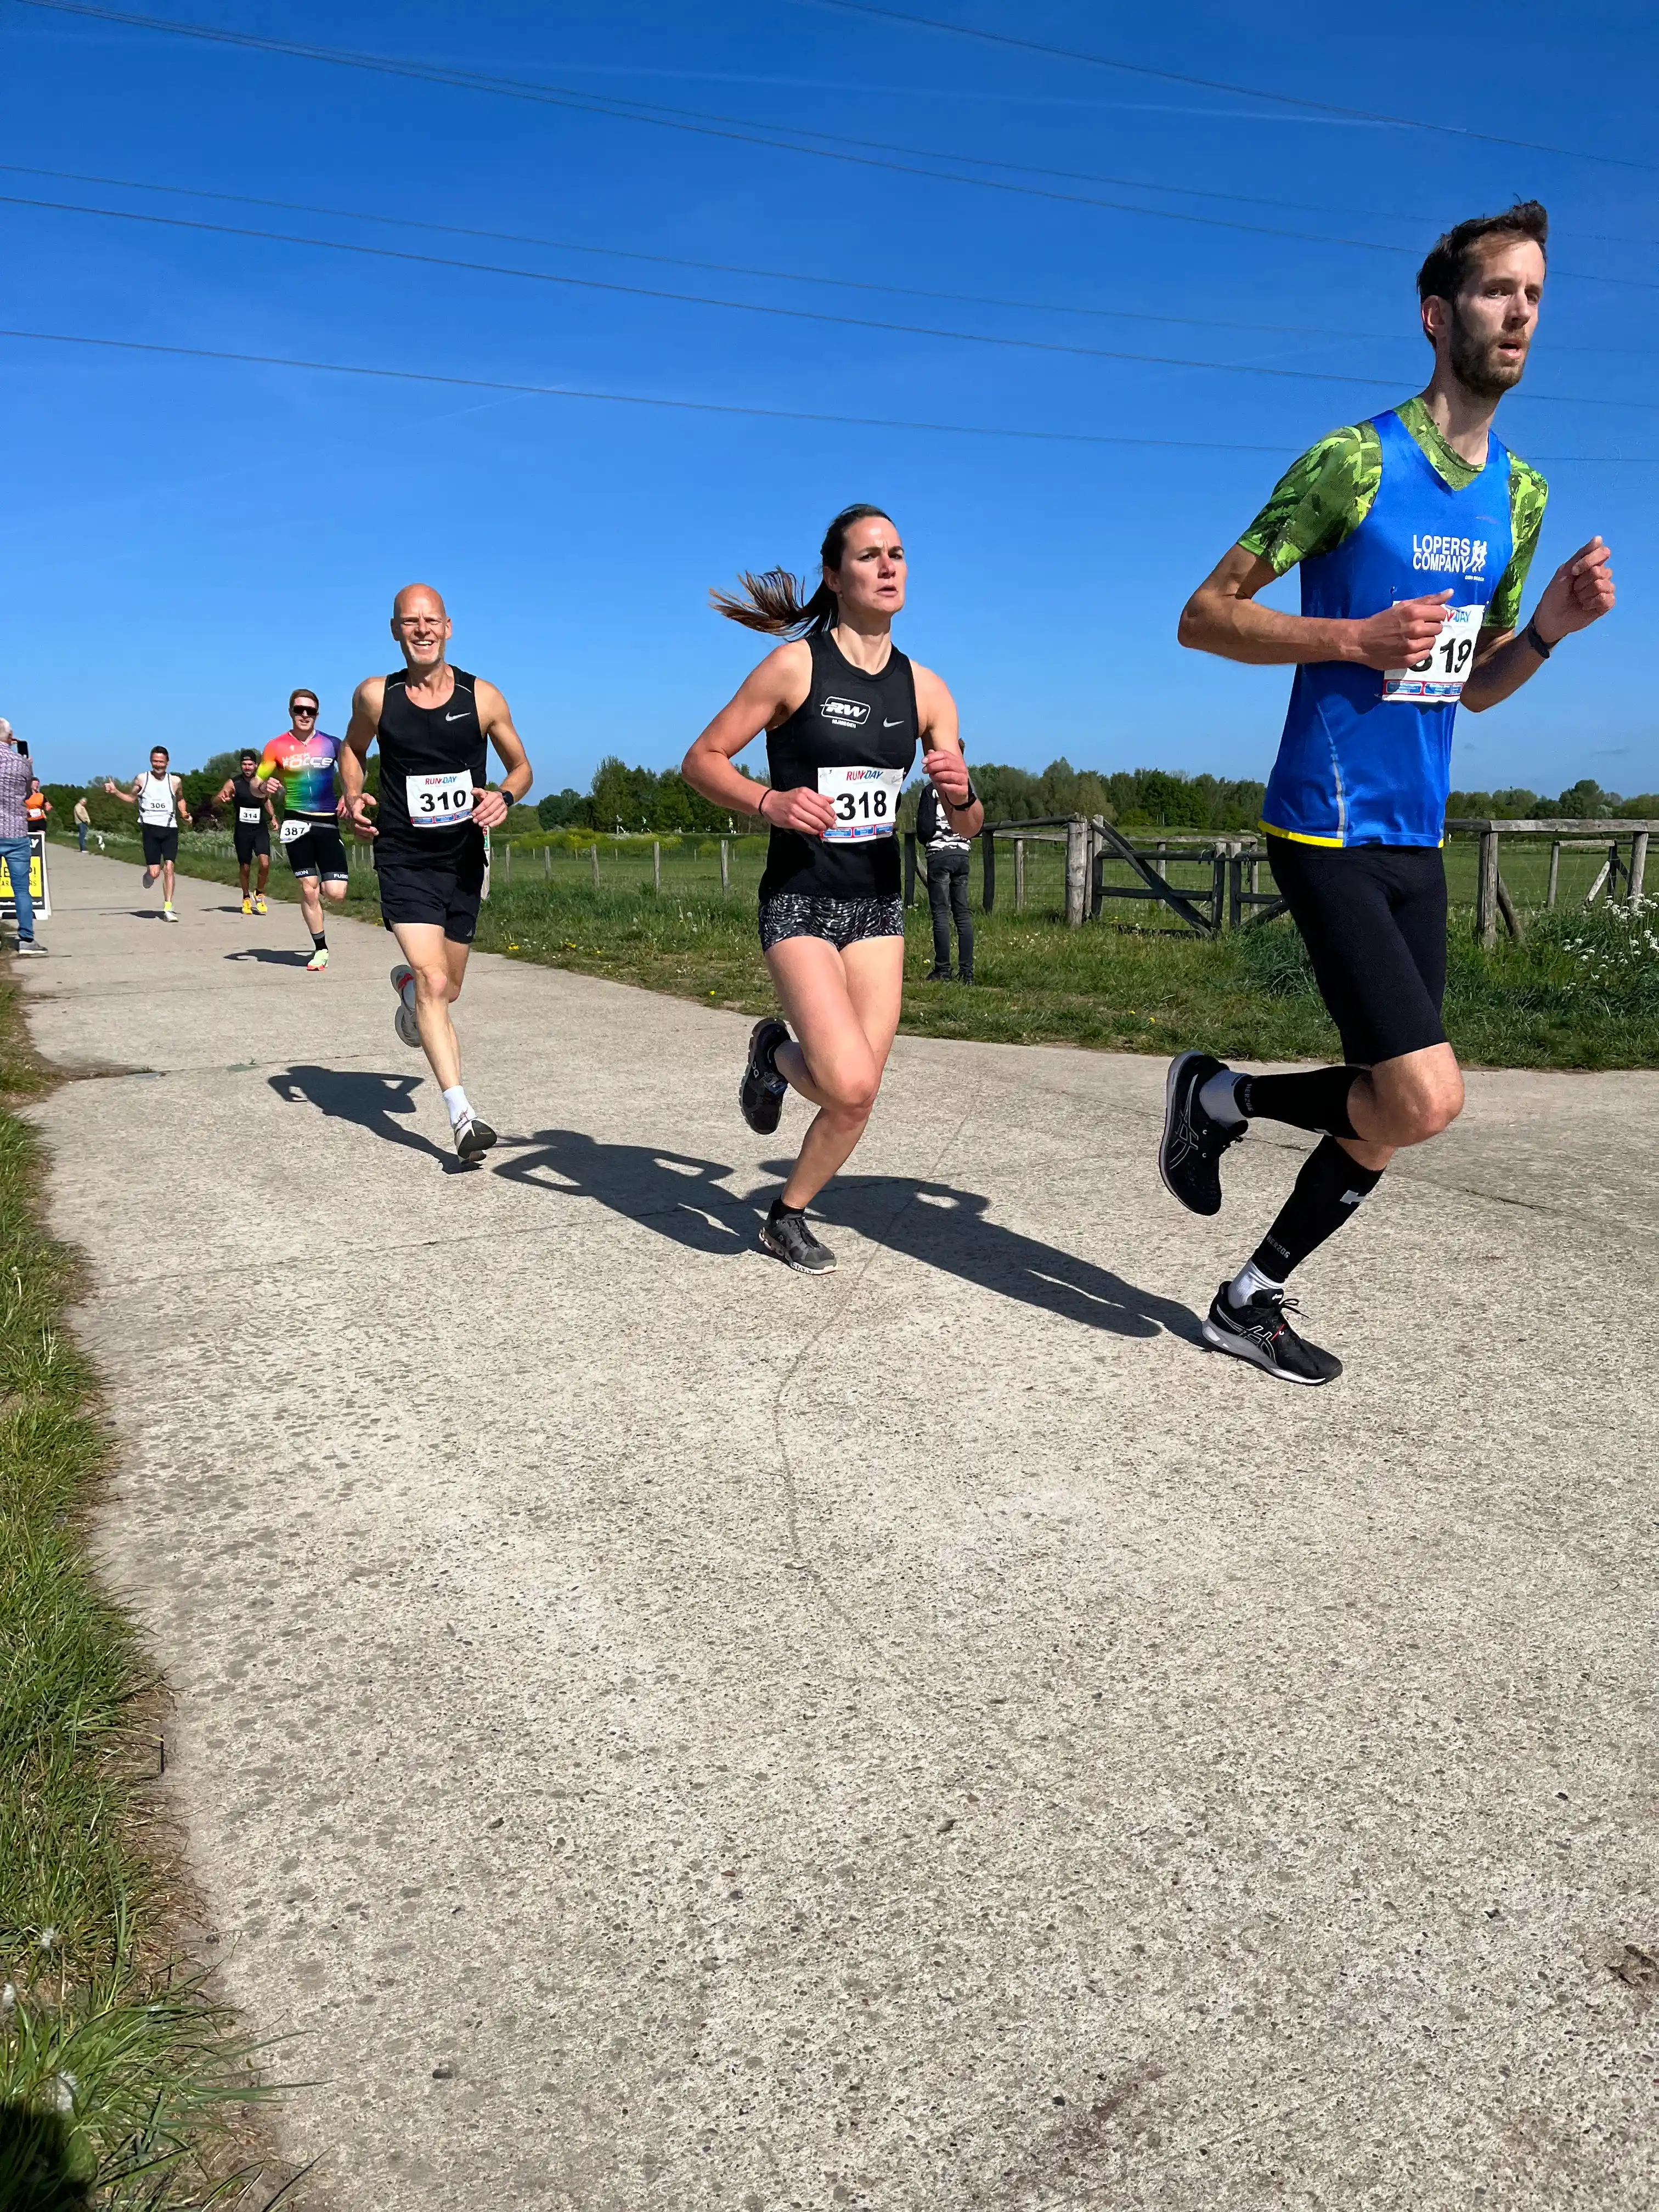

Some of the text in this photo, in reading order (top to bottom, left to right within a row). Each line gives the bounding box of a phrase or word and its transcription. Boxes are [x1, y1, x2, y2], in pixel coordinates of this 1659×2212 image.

[1413, 534, 1470, 556] LOPERS
[1413, 552, 1470, 573] COMPANY
[419, 789, 466, 812] 310
[836, 790, 887, 821] 318
[284, 827, 305, 836] 387
[1266, 1234, 1290, 1259] HERZOG
